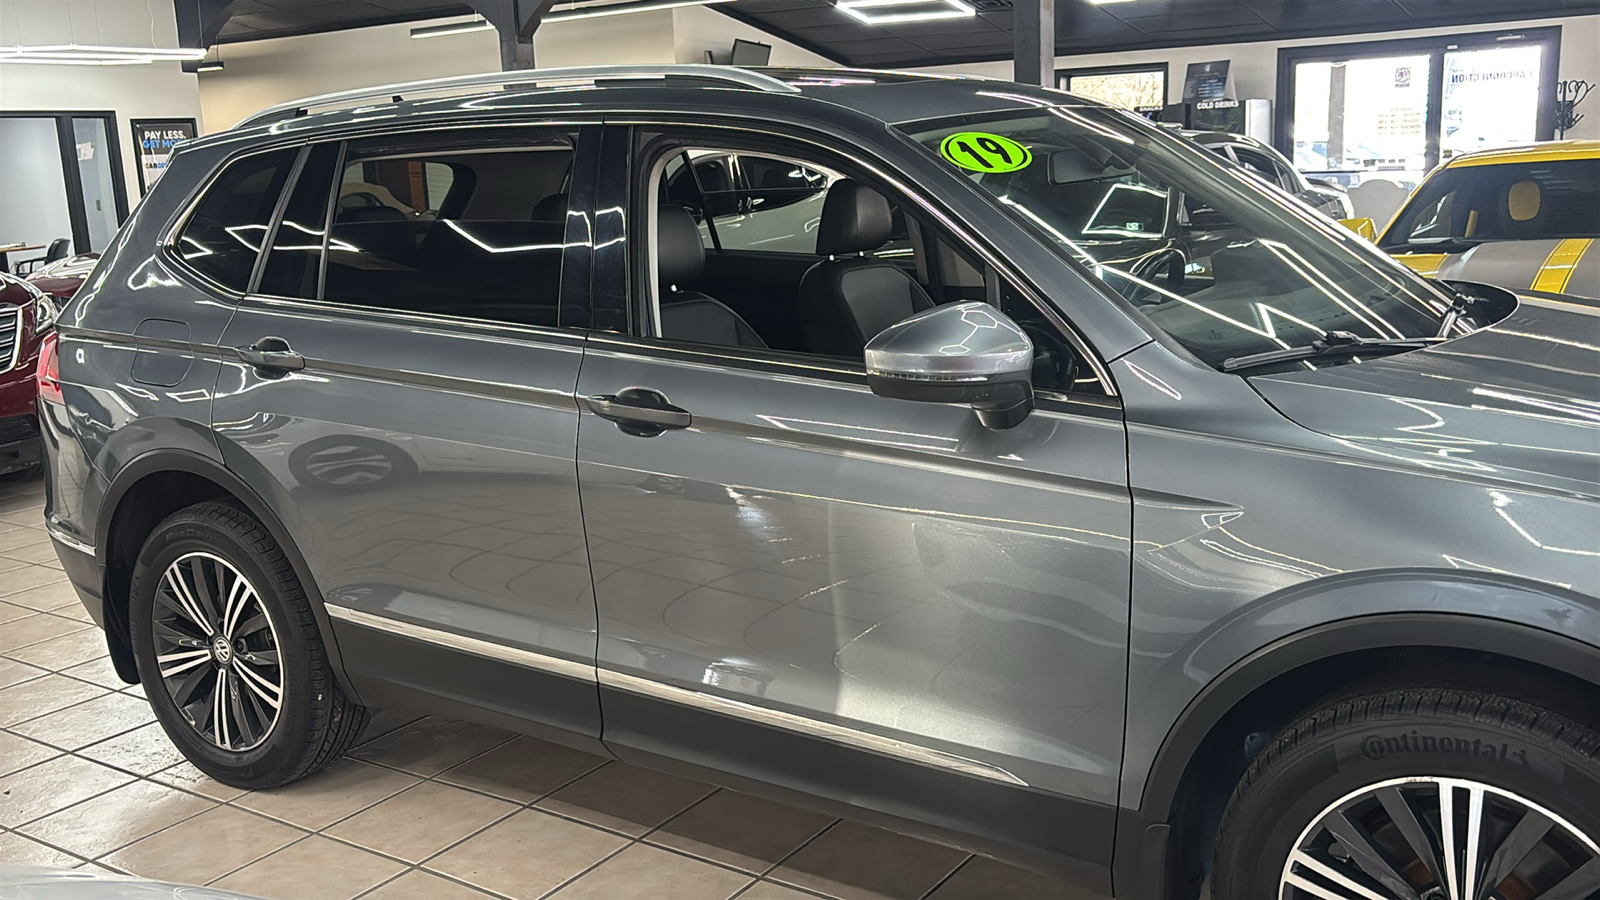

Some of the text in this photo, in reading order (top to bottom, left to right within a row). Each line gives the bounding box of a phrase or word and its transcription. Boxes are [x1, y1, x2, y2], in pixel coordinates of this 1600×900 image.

[1196, 100, 1239, 110] COLD DRINKS
[144, 130, 186, 140] PAY LESS.
[142, 139, 184, 149] GET MO
[956, 137, 1013, 169] 19
[1360, 729, 1508, 761] Continental
